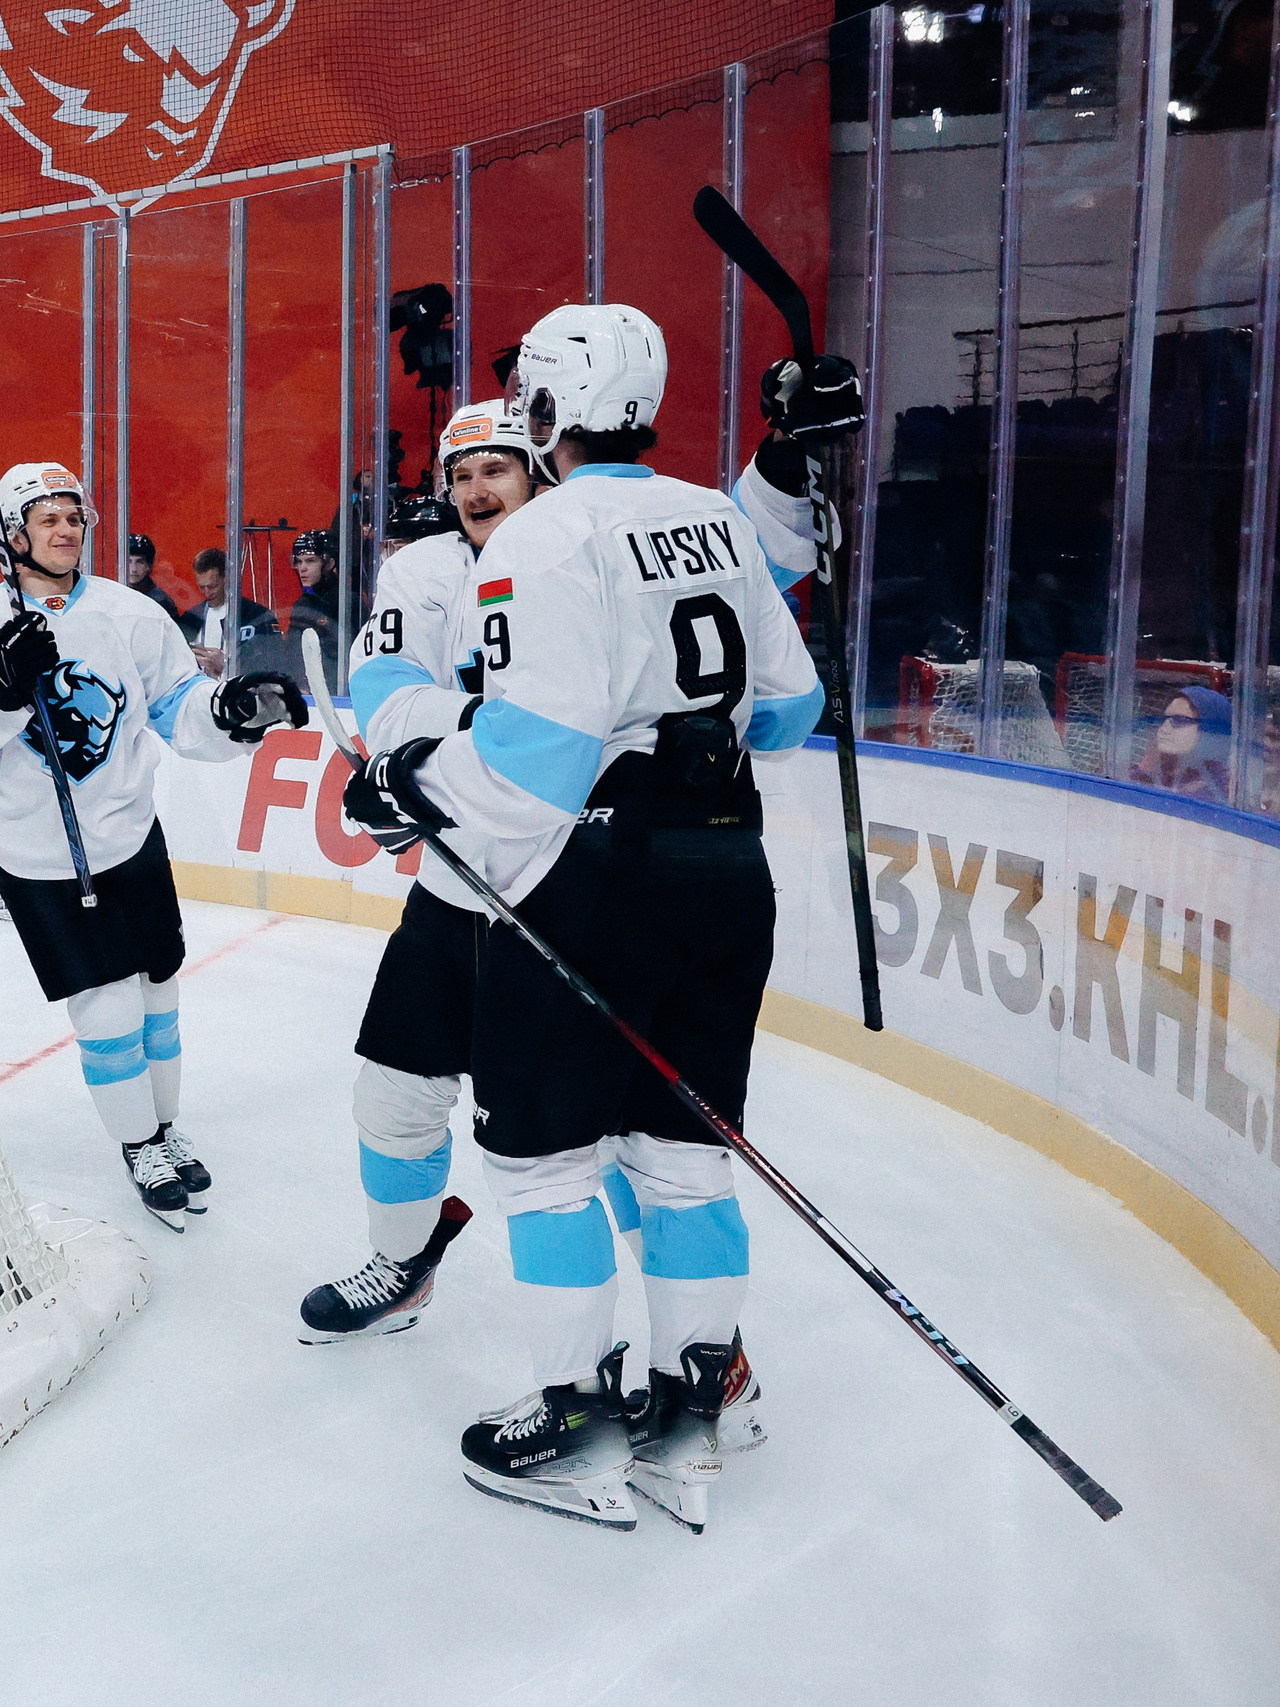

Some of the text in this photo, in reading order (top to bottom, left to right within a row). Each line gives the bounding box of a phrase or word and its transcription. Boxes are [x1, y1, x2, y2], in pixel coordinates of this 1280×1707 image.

[623, 401, 638, 425] 9
[806, 455, 832, 586] CCM
[363, 608, 403, 657] 69
[483, 611, 512, 672] 9
[669, 592, 747, 716] 9
[866, 820, 1280, 1168] 3X3.KHL.
[884, 1287, 970, 1366] CCM
